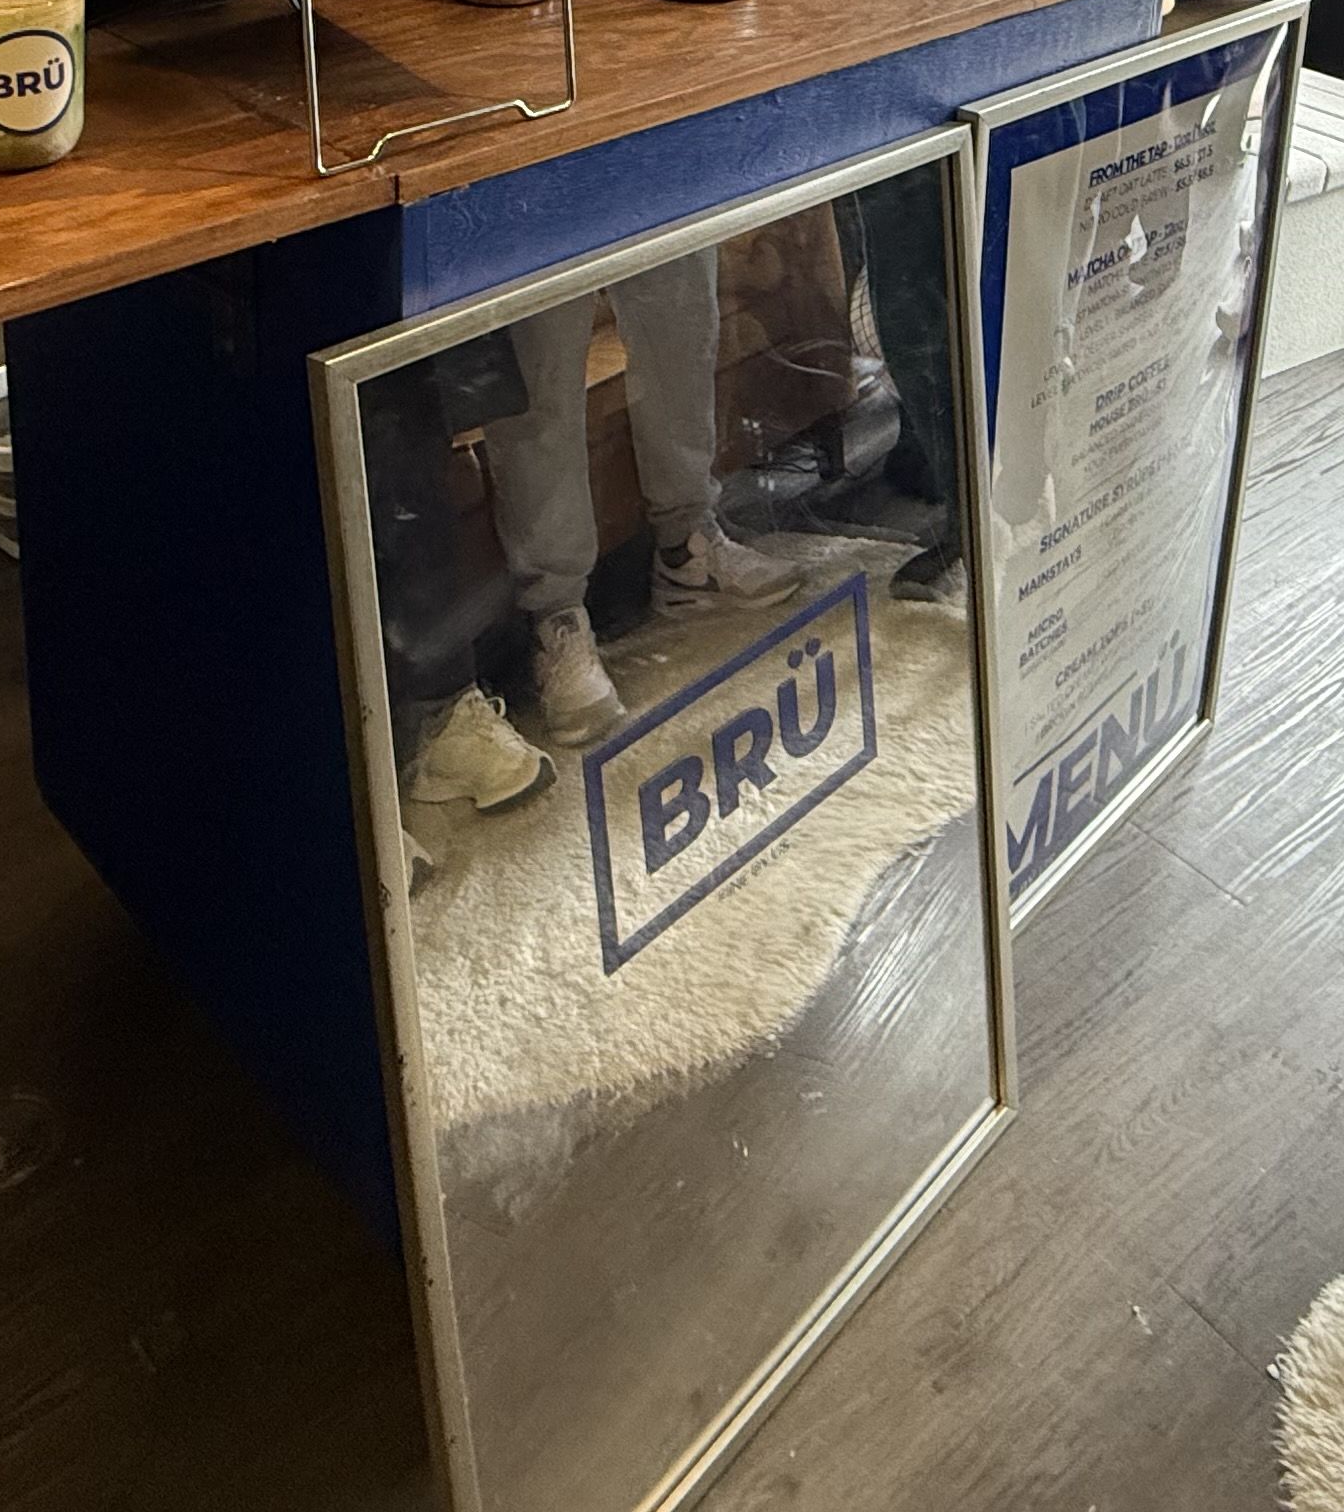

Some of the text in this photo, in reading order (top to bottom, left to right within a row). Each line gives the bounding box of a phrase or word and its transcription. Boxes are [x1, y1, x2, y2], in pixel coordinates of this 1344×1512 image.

[1090, 157, 1123, 188] FROM
[1125, 148, 1146, 174] THE
[1146, 139, 1167, 164] TAP
[1067, 249, 1115, 290] MATCHA
[1018, 541, 1081, 605] MAINSTAYS
[1028, 604, 1063, 645] MICRO
[638, 637, 837, 875] BRÜ
[1006, 628, 1187, 873] MENÜ
